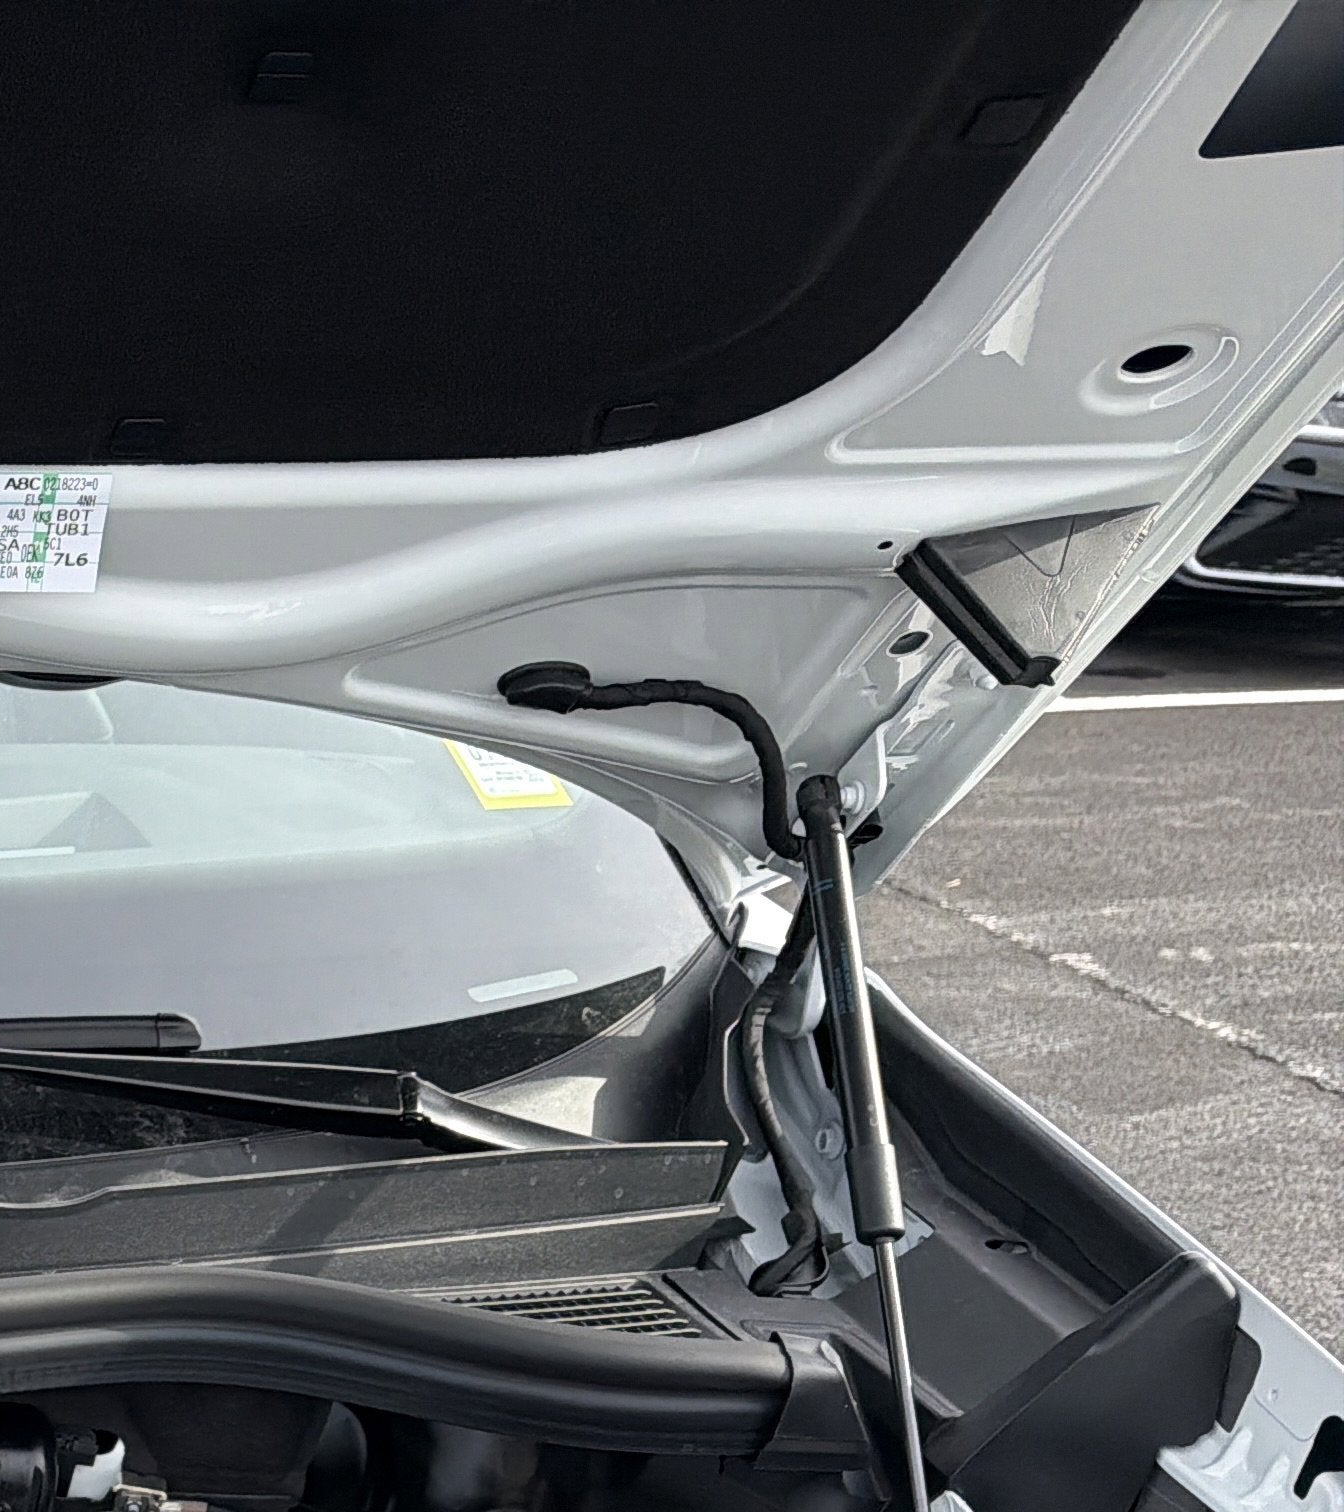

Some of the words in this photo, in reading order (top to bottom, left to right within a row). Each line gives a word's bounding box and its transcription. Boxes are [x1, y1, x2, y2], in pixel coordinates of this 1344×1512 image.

[4, 477, 42, 491] A8C
[77, 495, 97, 507] 4NH
[7, 509, 26, 521] 4A3
[54, 553, 88, 566] 7L6
